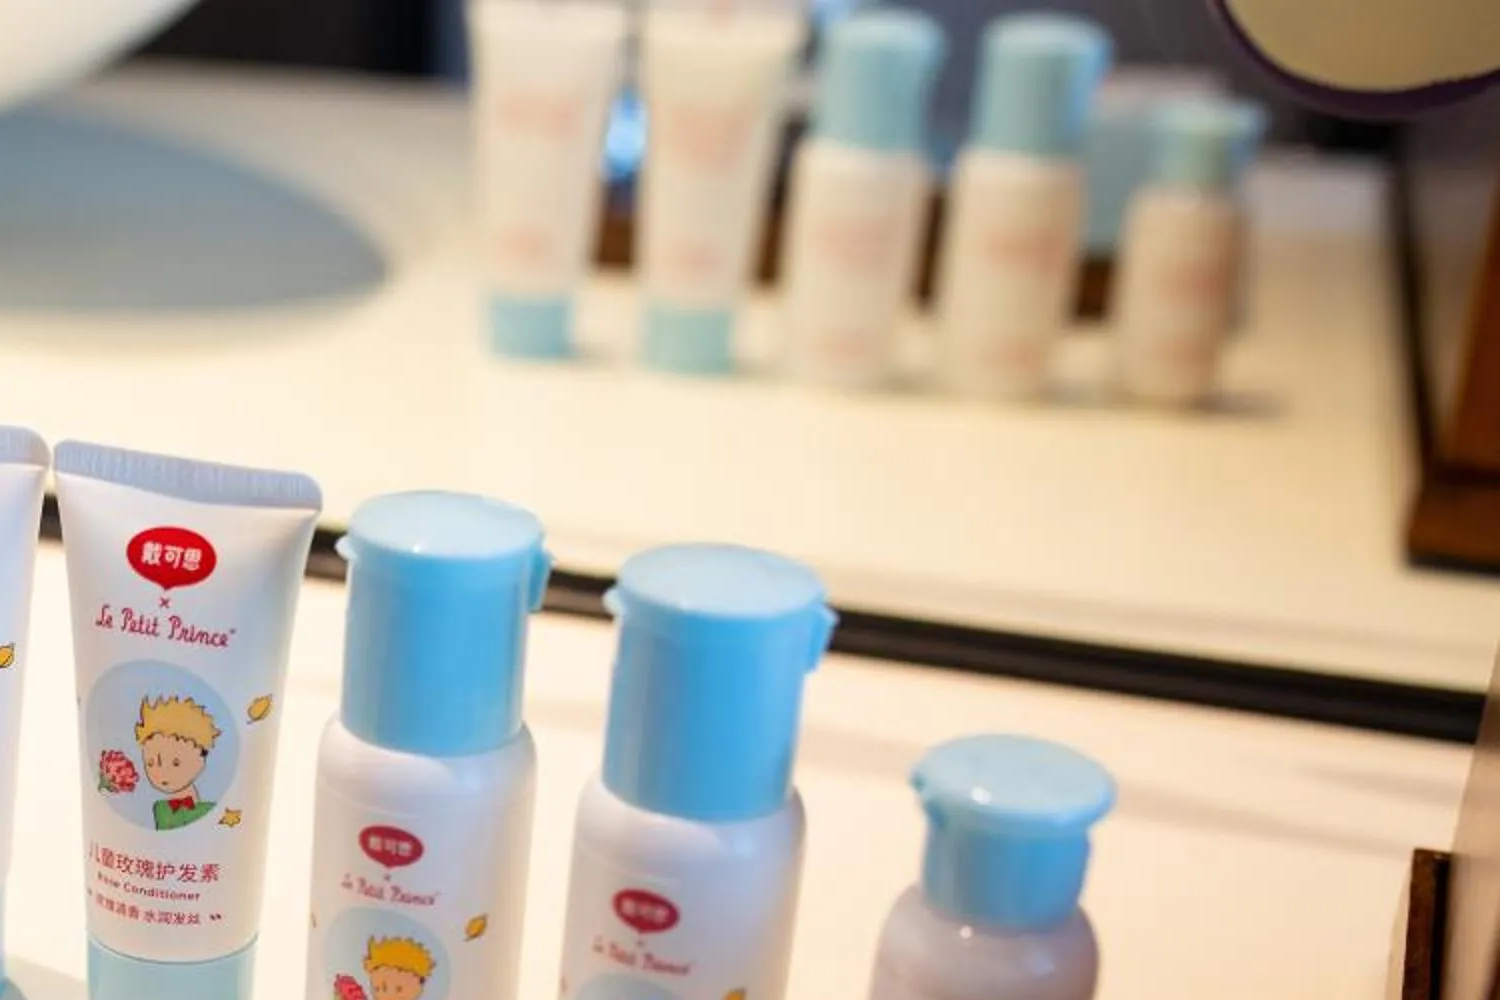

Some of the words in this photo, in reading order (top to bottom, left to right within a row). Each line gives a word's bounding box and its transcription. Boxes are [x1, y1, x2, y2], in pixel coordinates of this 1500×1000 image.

[141, 541, 202, 572] 戴可思
[95, 604, 113, 629] Le
[121, 607, 160, 638] Petit
[167, 615, 229, 647] Prince
[88, 842, 220, 884] 儿童玫瑰护发素
[123, 880, 202, 902] Conditioner
